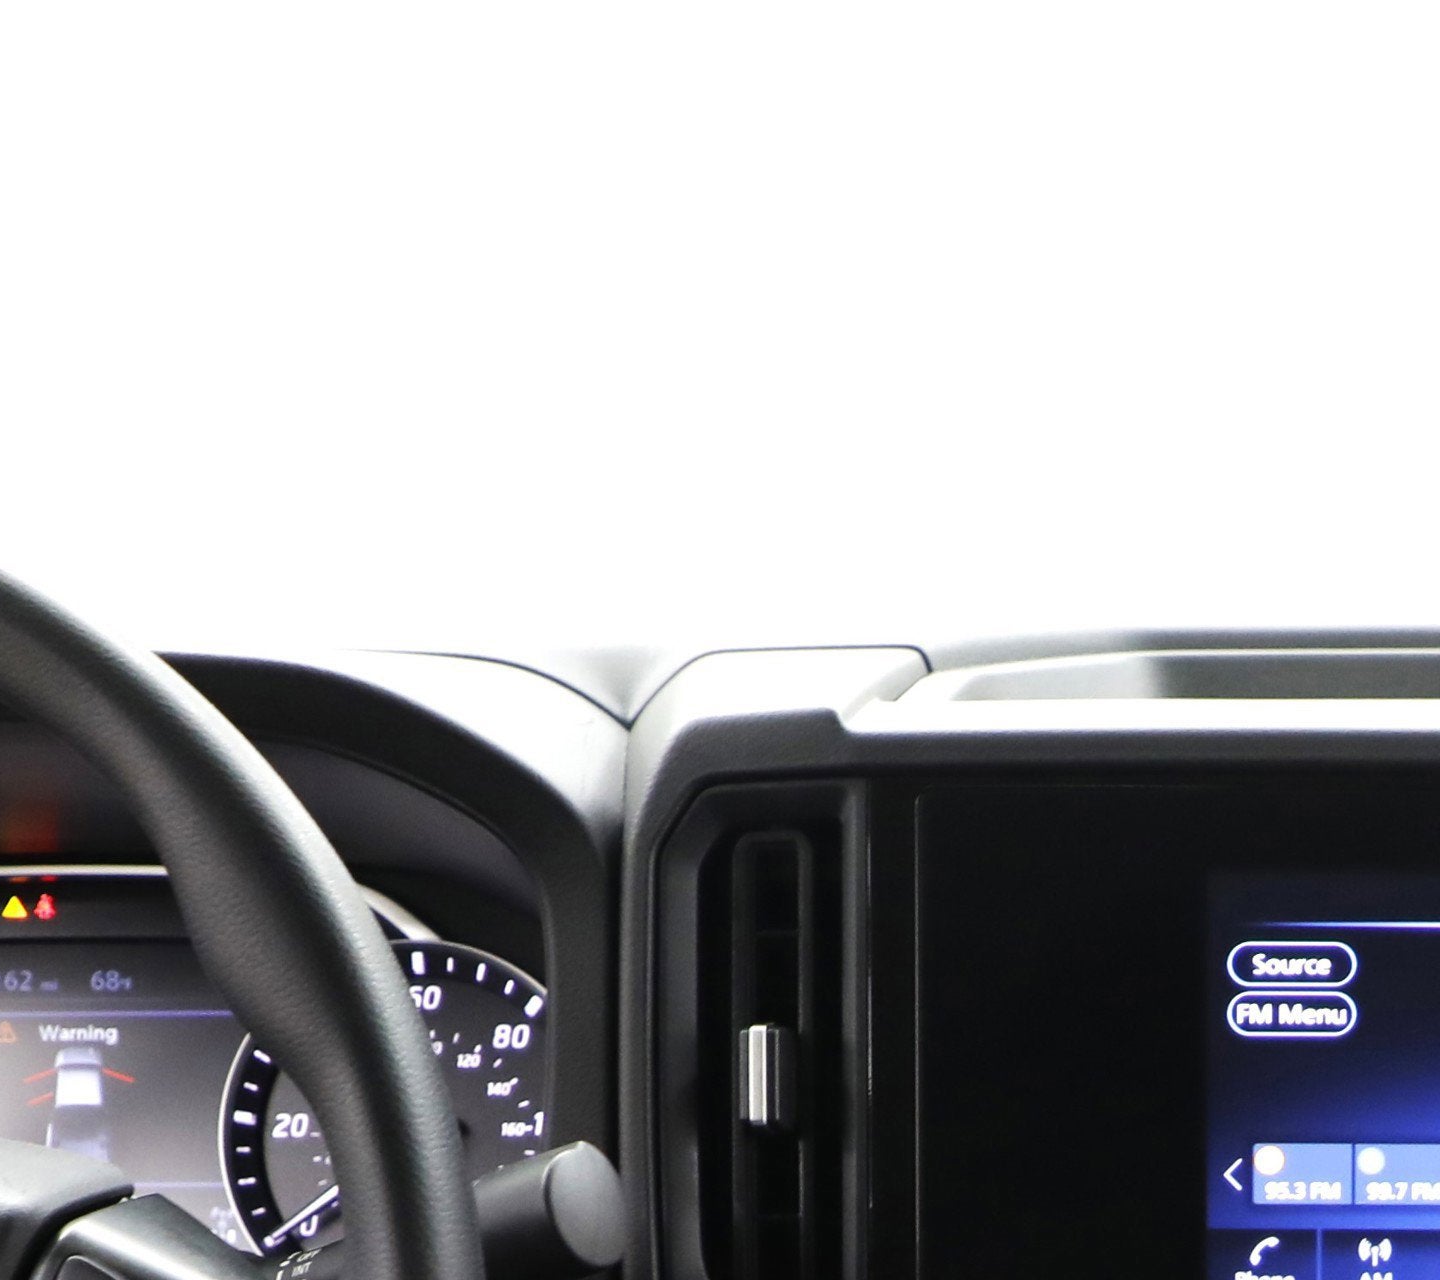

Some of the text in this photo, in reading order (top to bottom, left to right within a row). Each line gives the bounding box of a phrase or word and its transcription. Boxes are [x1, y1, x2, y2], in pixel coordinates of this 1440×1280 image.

[1252, 953, 1331, 977] Source
[1235, 1003, 1348, 1026] FM Menu
[39, 1025, 119, 1045] Warning
[492, 1024, 531, 1049] 80
[457, 1053, 481, 1068] 120
[272, 1112, 309, 1138] 20
[1310, 1182, 1342, 1200] FM
